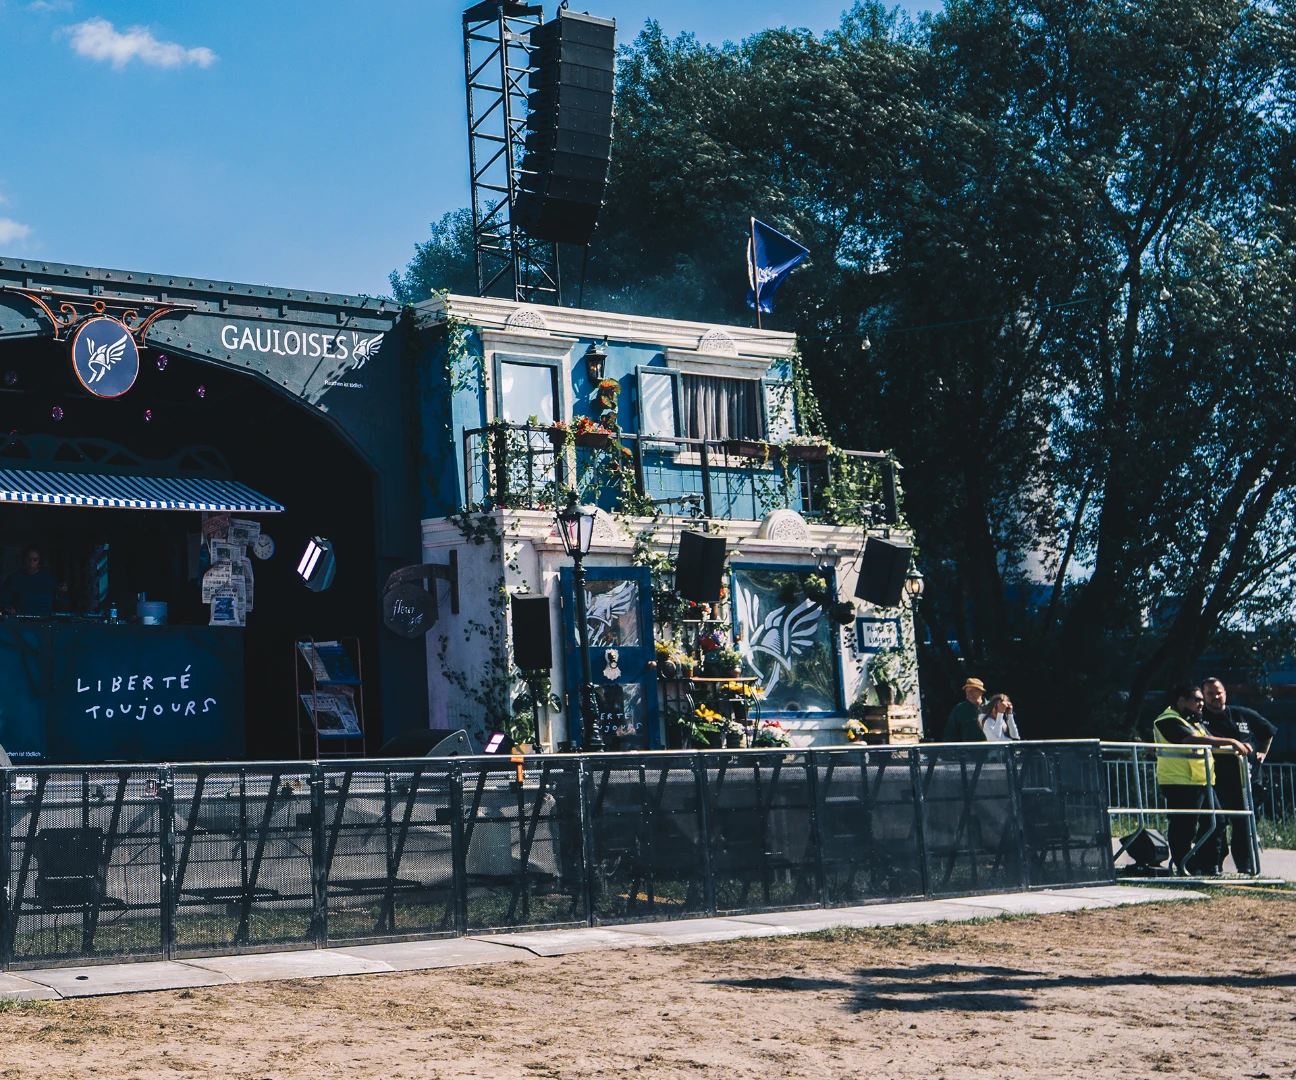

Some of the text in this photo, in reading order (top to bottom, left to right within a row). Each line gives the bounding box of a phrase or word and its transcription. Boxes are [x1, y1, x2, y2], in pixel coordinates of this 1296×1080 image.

[221, 325, 349, 360] GAULOISES
[77, 664, 192, 693] LIBERTÉ
[600, 708, 630, 720] ERTÉ
